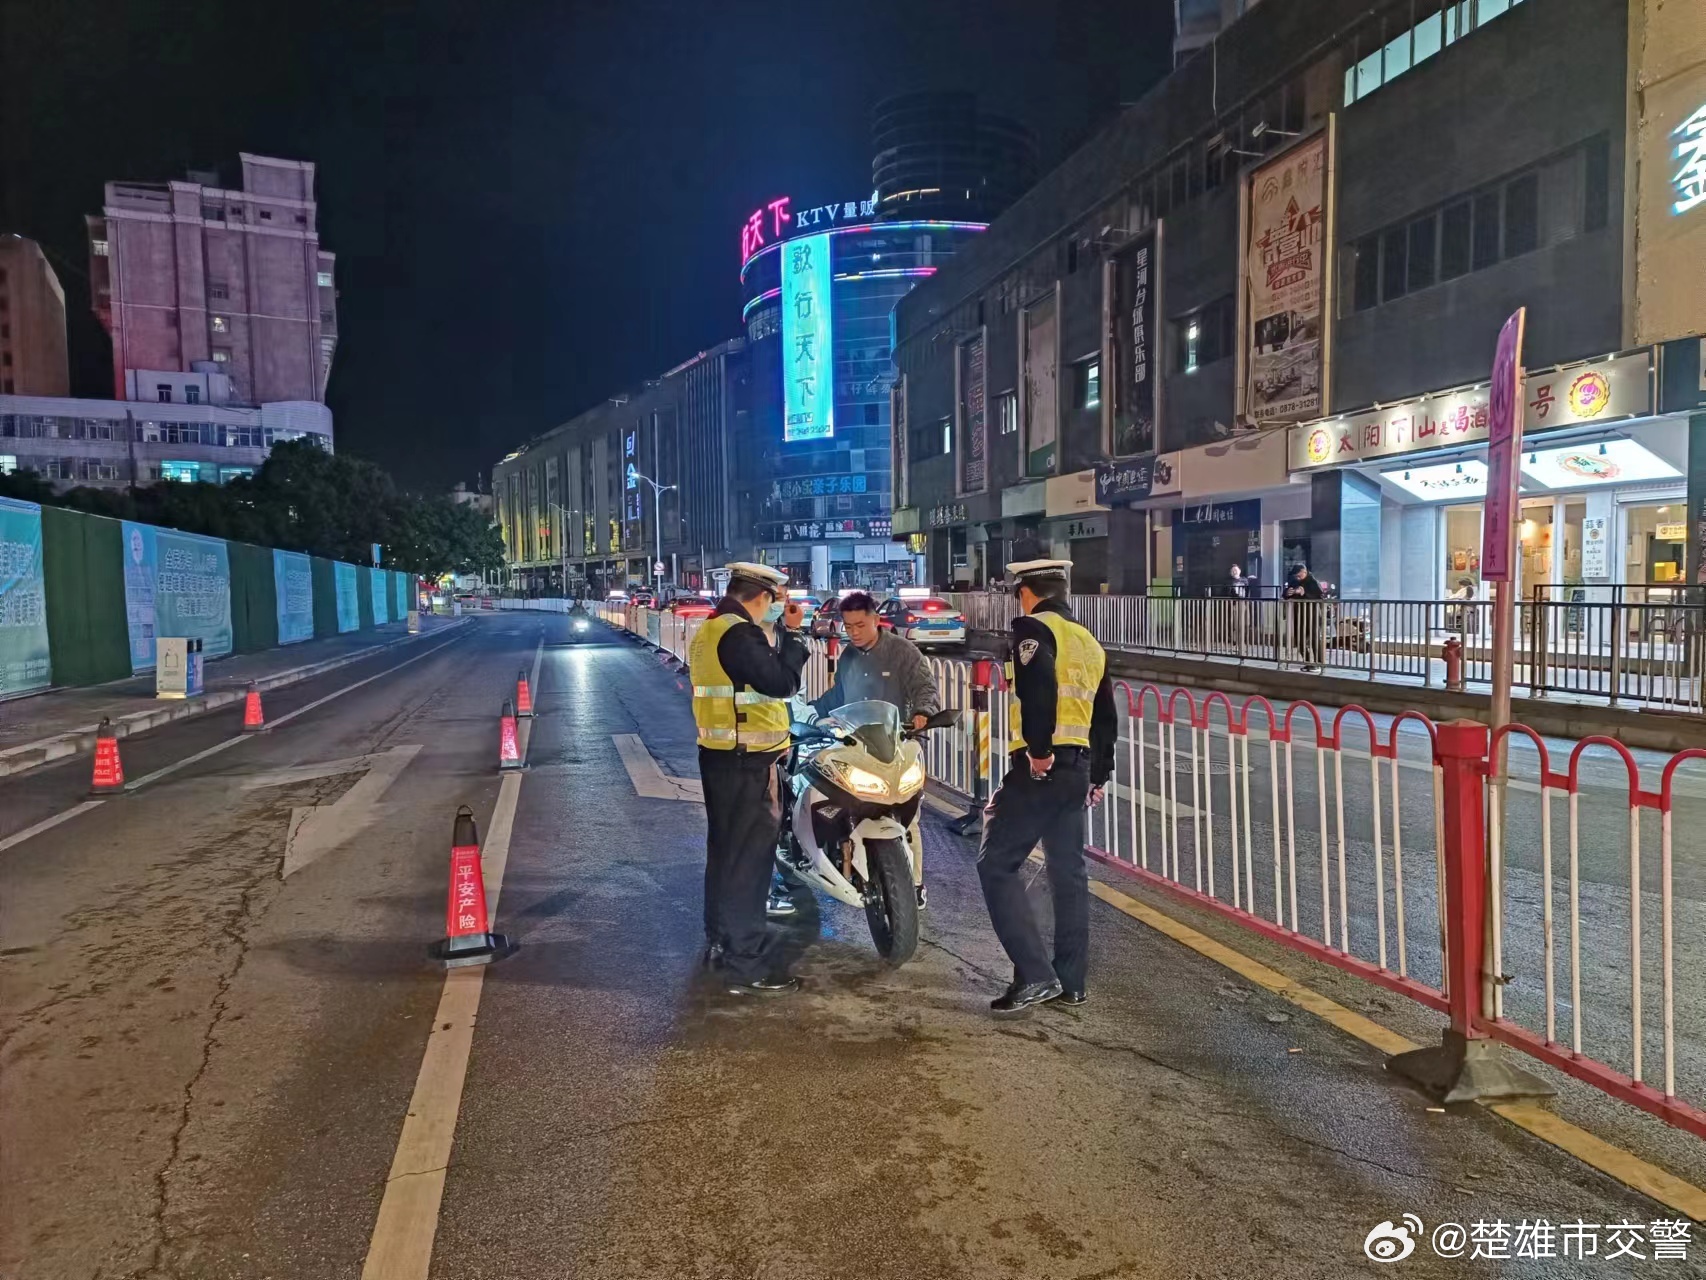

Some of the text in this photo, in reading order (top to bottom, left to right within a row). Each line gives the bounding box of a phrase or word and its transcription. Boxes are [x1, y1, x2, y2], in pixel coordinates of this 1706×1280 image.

[1132, 247, 1148, 383] 星河台球俱乐部
[1337, 384, 1555, 454] 太阳下山是喝酒号
[458, 865, 477, 930] 平安产险
